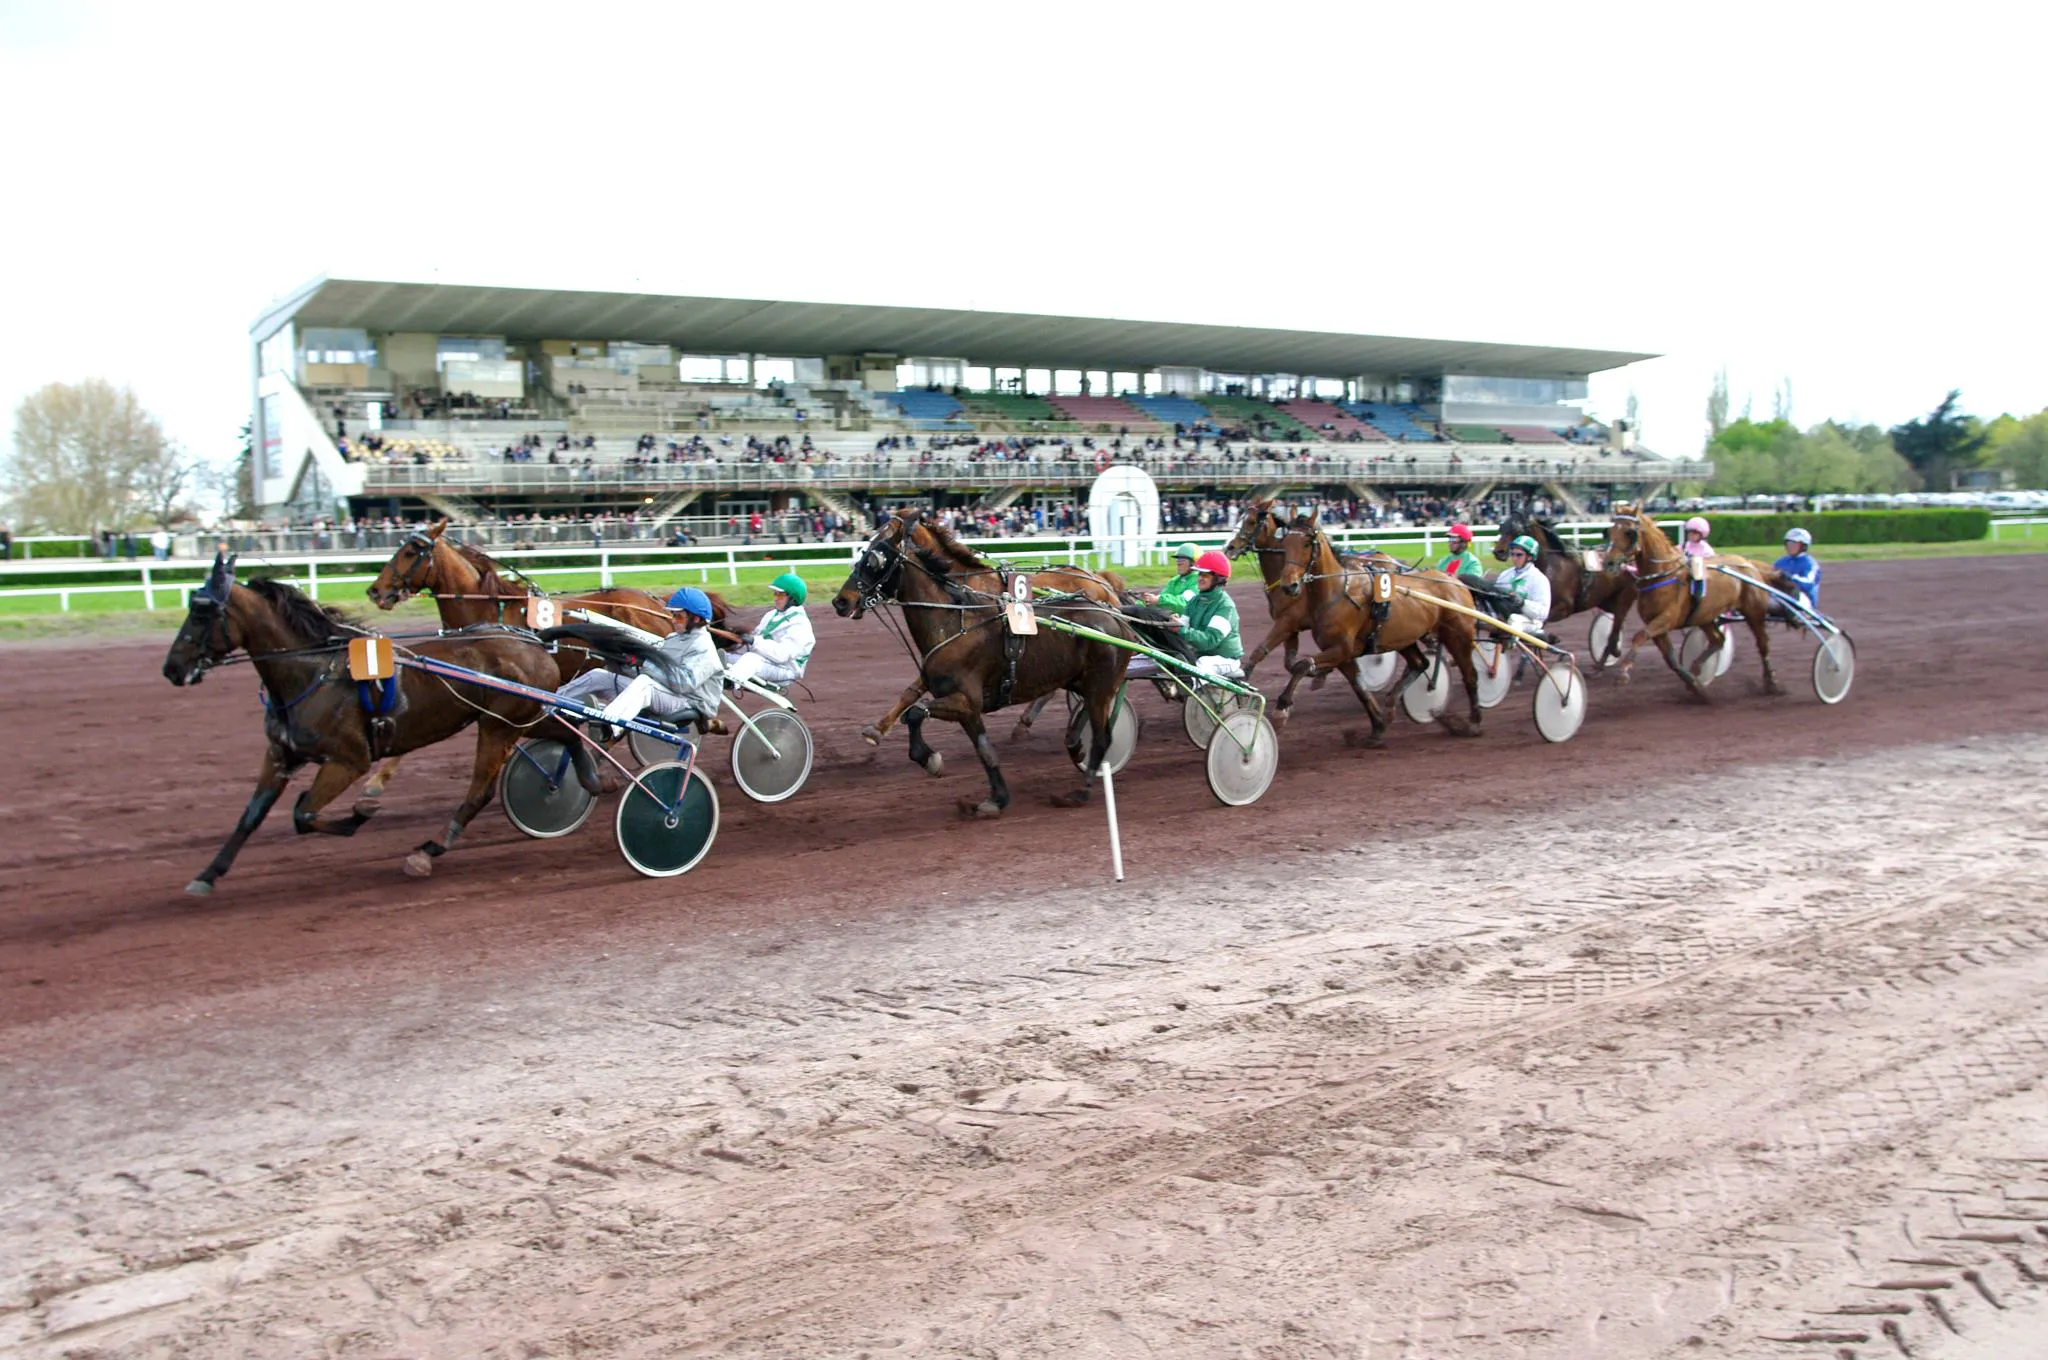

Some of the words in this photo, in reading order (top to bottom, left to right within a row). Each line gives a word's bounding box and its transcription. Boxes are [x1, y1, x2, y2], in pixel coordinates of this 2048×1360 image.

[1014, 575, 1027, 600] 6
[1380, 573, 1391, 598] 9
[536, 600, 554, 629] 8
[1014, 602, 1032, 631] 2
[366, 639, 379, 676] 1
